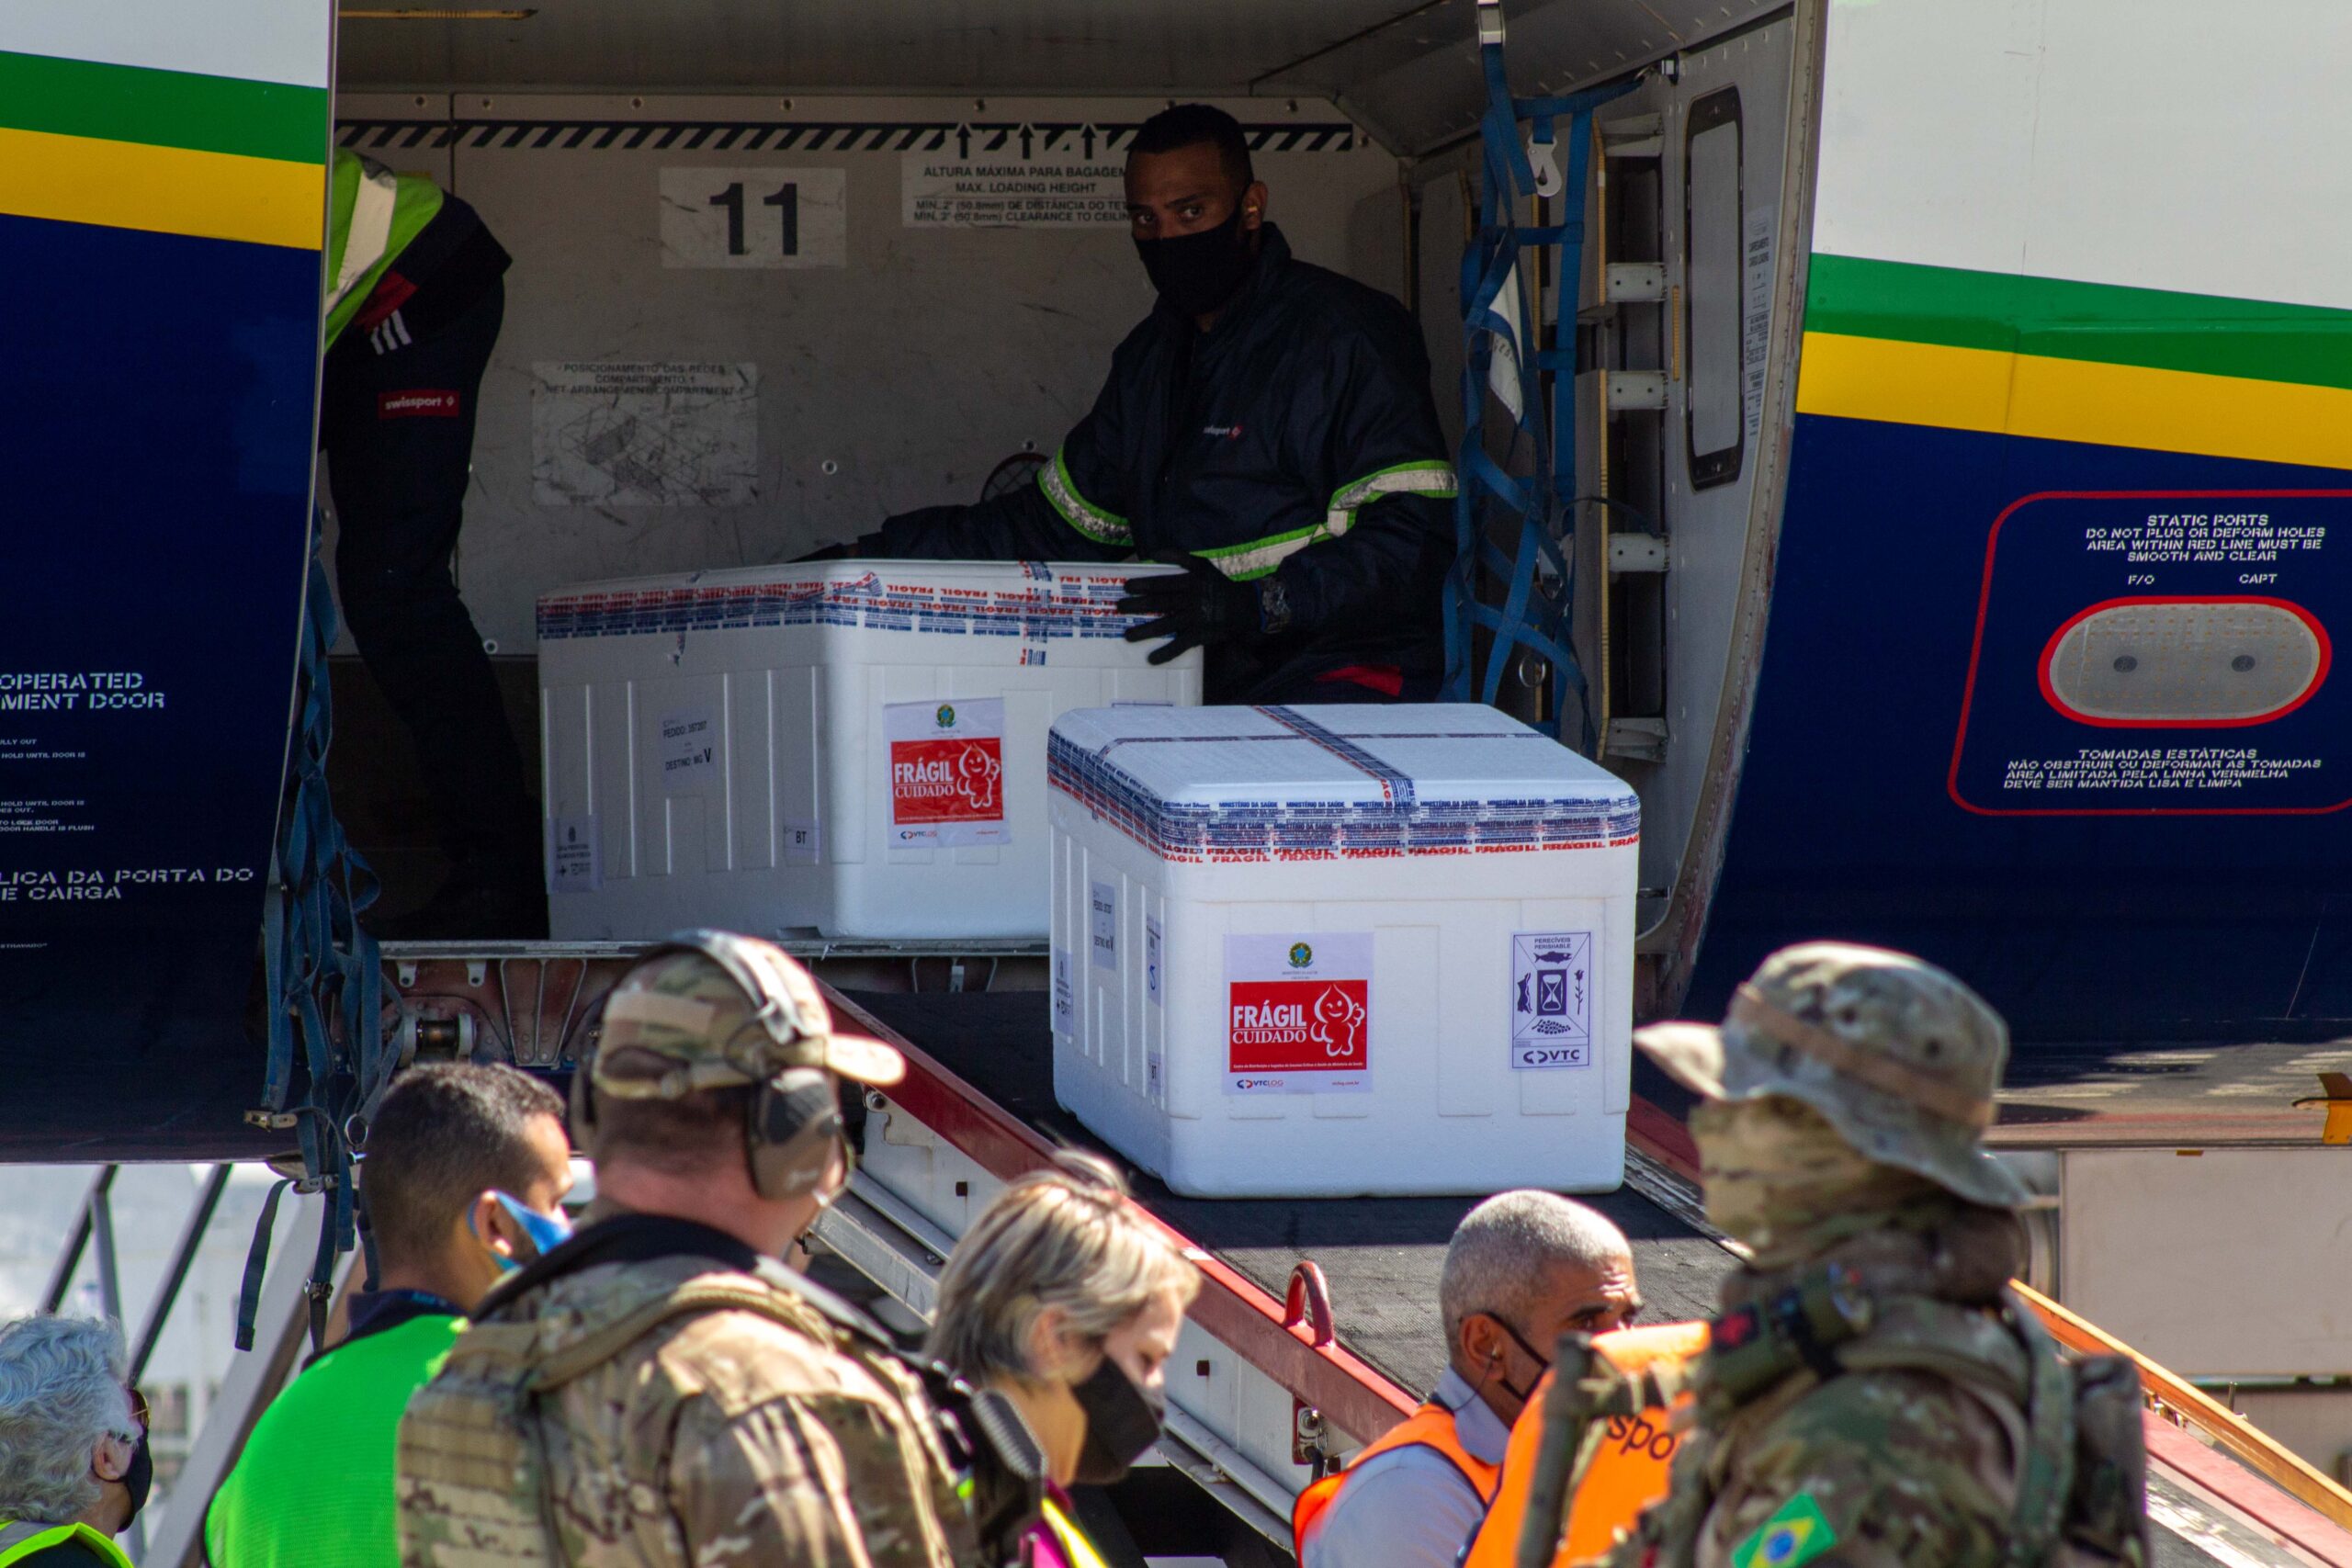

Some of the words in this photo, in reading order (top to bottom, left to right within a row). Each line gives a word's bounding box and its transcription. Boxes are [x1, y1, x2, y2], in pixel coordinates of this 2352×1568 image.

[924, 166, 972, 177] ALTURA
[976, 164, 1025, 177] MÁXIMA
[1029, 167, 1062, 177] PARA
[956, 183, 986, 193] MAX.
[989, 183, 1046, 193] LOADING
[1050, 183, 1096, 193] HEIGHT
[1008, 201, 1023, 209] DE
[1089, 201, 1104, 210] DO
[709, 182, 797, 255] 11
[1005, 212, 1072, 221] CLEARANCE
[1076, 212, 1091, 221] TO
[385, 397, 441, 411] swissport
[2147, 514, 2208, 526] STATIC
[2212, 514, 2269, 526] PORTS
[2086, 528, 2108, 538] DO
[2110, 528, 2143, 538] NOT
[2146, 528, 2184, 538] PLUG
[2188, 528, 2209, 538] OR
[2212, 528, 2274, 538] DEFORM
[2278, 528, 2325, 538] HOLES
[2086, 540, 2126, 550] AREA
[2132, 540, 2184, 550] WITHIN
[2187, 540, 2217, 550] RED
[2221, 540, 2255, 550] LINE
[2257, 540, 2299, 550] MUST
[2302, 540, 2323, 550] BE
[2127, 551, 2190, 561] SMOOTH
[2193, 551, 2225, 561] AND
[2229, 551, 2278, 561] CLEAR
[2128, 574, 2155, 584] F/O
[2239, 574, 2278, 584] CAPT
[887, 584, 933, 595] FRÁGIL
[941, 588, 987, 598] FRÁGIL
[0, 672, 142, 690] OPERATED
[88, 692, 164, 709] DOOR
[704, 748, 711, 762] V
[2078, 748, 2162, 760] TOMADAS
[2165, 748, 2257, 760] ESTÁTICAS
[2007, 759, 2040, 769] NÃO
[2043, 759, 2114, 769] OBSTRUIR
[2118, 759, 2139, 769] OU
[2142, 759, 2222, 769] DEFORMAR
[2225, 759, 2245, 769] AS
[2248, 759, 2322, 769] TOMADAS
[894, 757, 954, 784] FRÁGIL
[2049, 769, 2118, 778] LIMITADA
[2121, 769, 2158, 778] PELA
[2163, 769, 2206, 778] LINHA
[2211, 769, 2289, 778] VERMELHA
[2003, 779, 2042, 788] DEVE
[2046, 779, 2074, 788] SER
[2077, 779, 2143, 788] MANTIDA
[2148, 779, 2180, 788] LISA
[2184, 779, 2195, 788] E
[2199, 779, 2242, 788] LIMPA
[895, 784, 955, 797] CUIDADO
[1206, 846, 1264, 855] FRÁGIL
[1213, 854, 1271, 863] FRÁGIL
[67, 870, 104, 885] DA
[114, 868, 205, 884] PORTA
[215, 868, 254, 882] DO
[28, 886, 121, 900] CARGA
[1233, 999, 1307, 1028] FRÁGIL
[1232, 1030, 1307, 1043] CUIDADO
[1549, 1049, 1580, 1060] VTC
